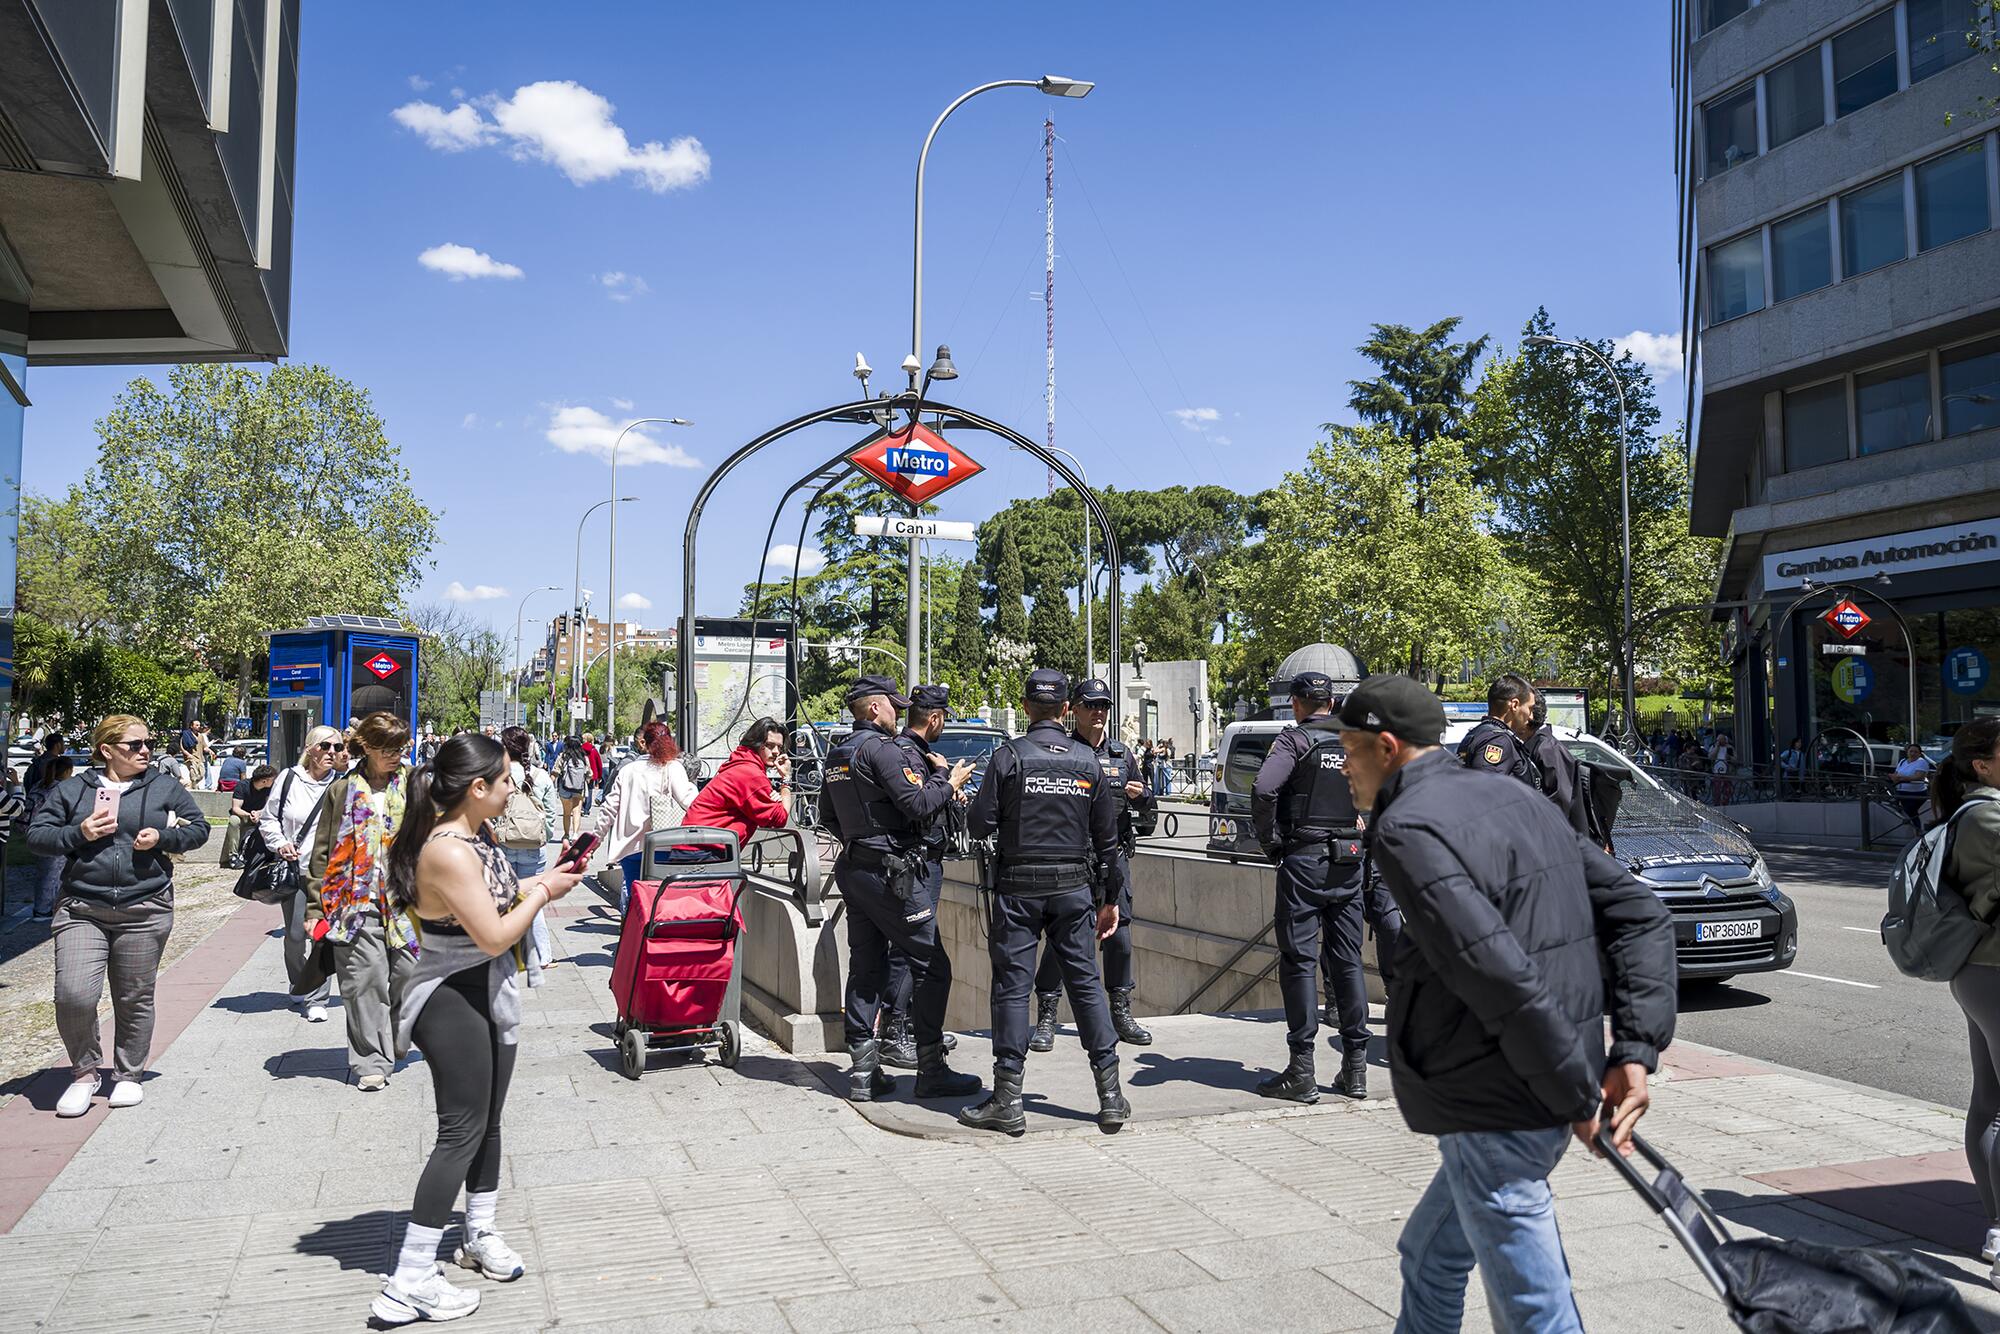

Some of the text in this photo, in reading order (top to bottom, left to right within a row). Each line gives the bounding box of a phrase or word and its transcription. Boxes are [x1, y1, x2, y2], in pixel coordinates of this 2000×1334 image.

[892, 451, 945, 472] Metro
[1776, 532, 1998, 578] Gamboa Automoción
[1839, 613, 1859, 623] Metro
[374, 661, 391, 670] Metro
[1025, 777, 1080, 787] POLICIA
[1025, 785, 1090, 797] NACIONAL
[1702, 922, 1759, 939] CNP3609AP
